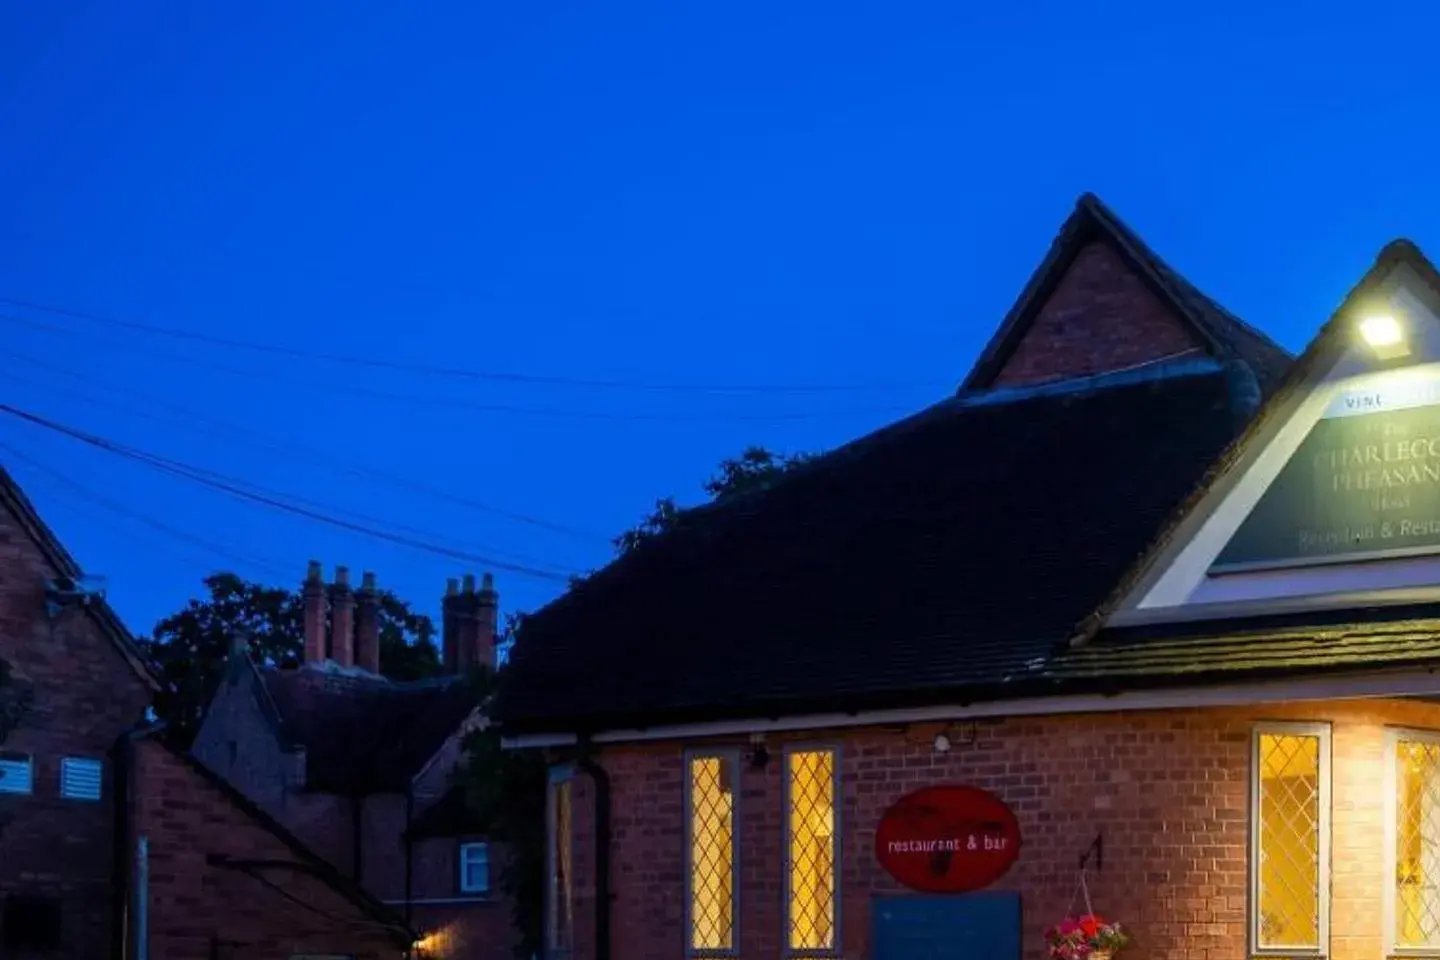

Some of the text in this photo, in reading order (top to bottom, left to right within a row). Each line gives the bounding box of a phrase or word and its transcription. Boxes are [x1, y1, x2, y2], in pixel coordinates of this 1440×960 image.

[887, 834, 1008, 854] restaurant & bar
